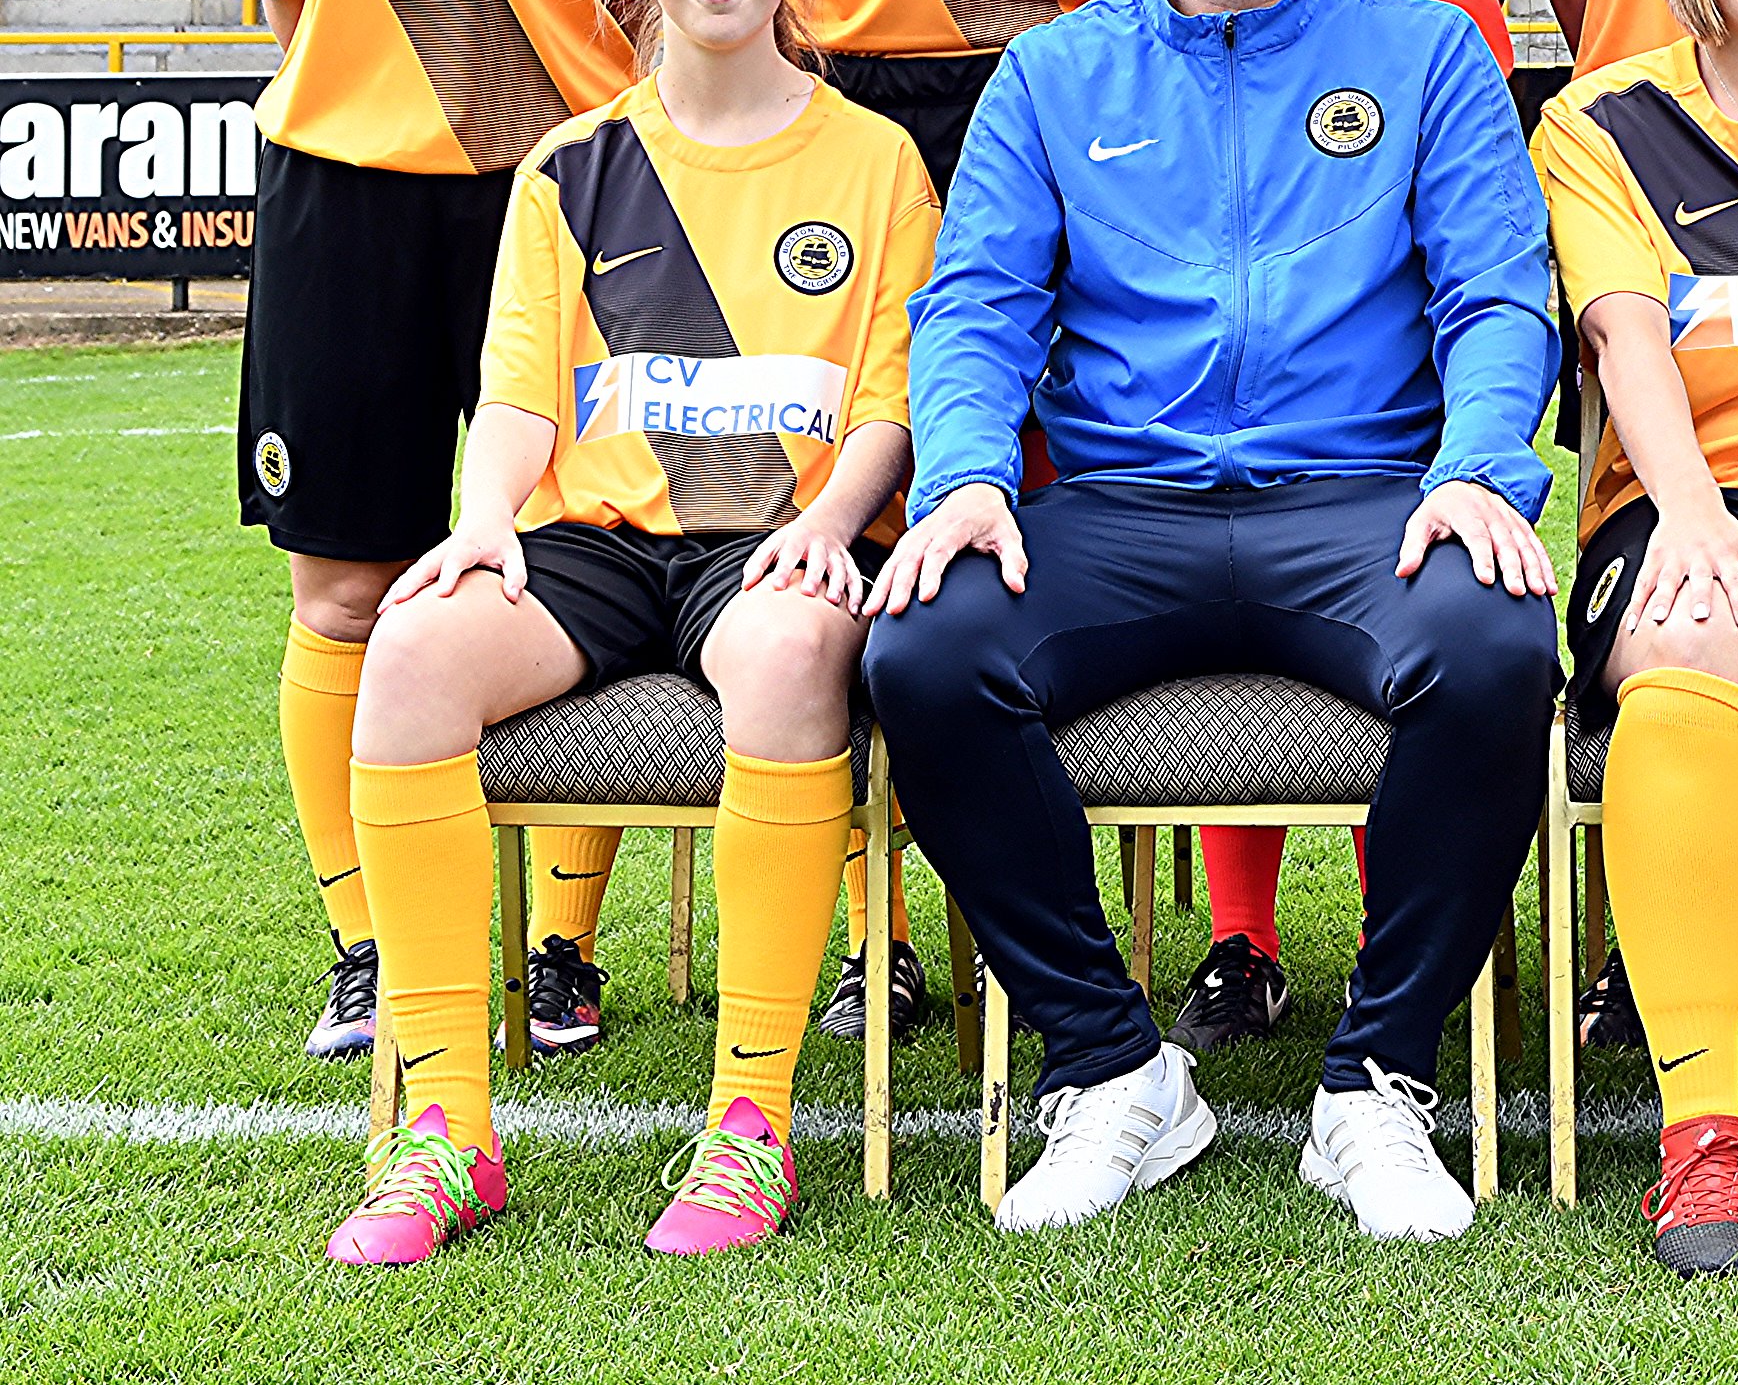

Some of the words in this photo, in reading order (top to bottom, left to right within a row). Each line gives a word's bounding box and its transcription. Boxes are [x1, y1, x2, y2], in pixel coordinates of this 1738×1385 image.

[1313, 95, 1341, 124] BOSTON
[1348, 94, 1376, 117] UNITED
[1337, 127, 1375, 150] PILGRIMS
[64, 212, 149, 249] VANS
[152, 210, 177, 249] &
[782, 228, 814, 254] BOSTON
[821, 228, 846, 257] UNITED
[645, 355, 703, 388] CV
[643, 401, 834, 444] ELECTRICAL
